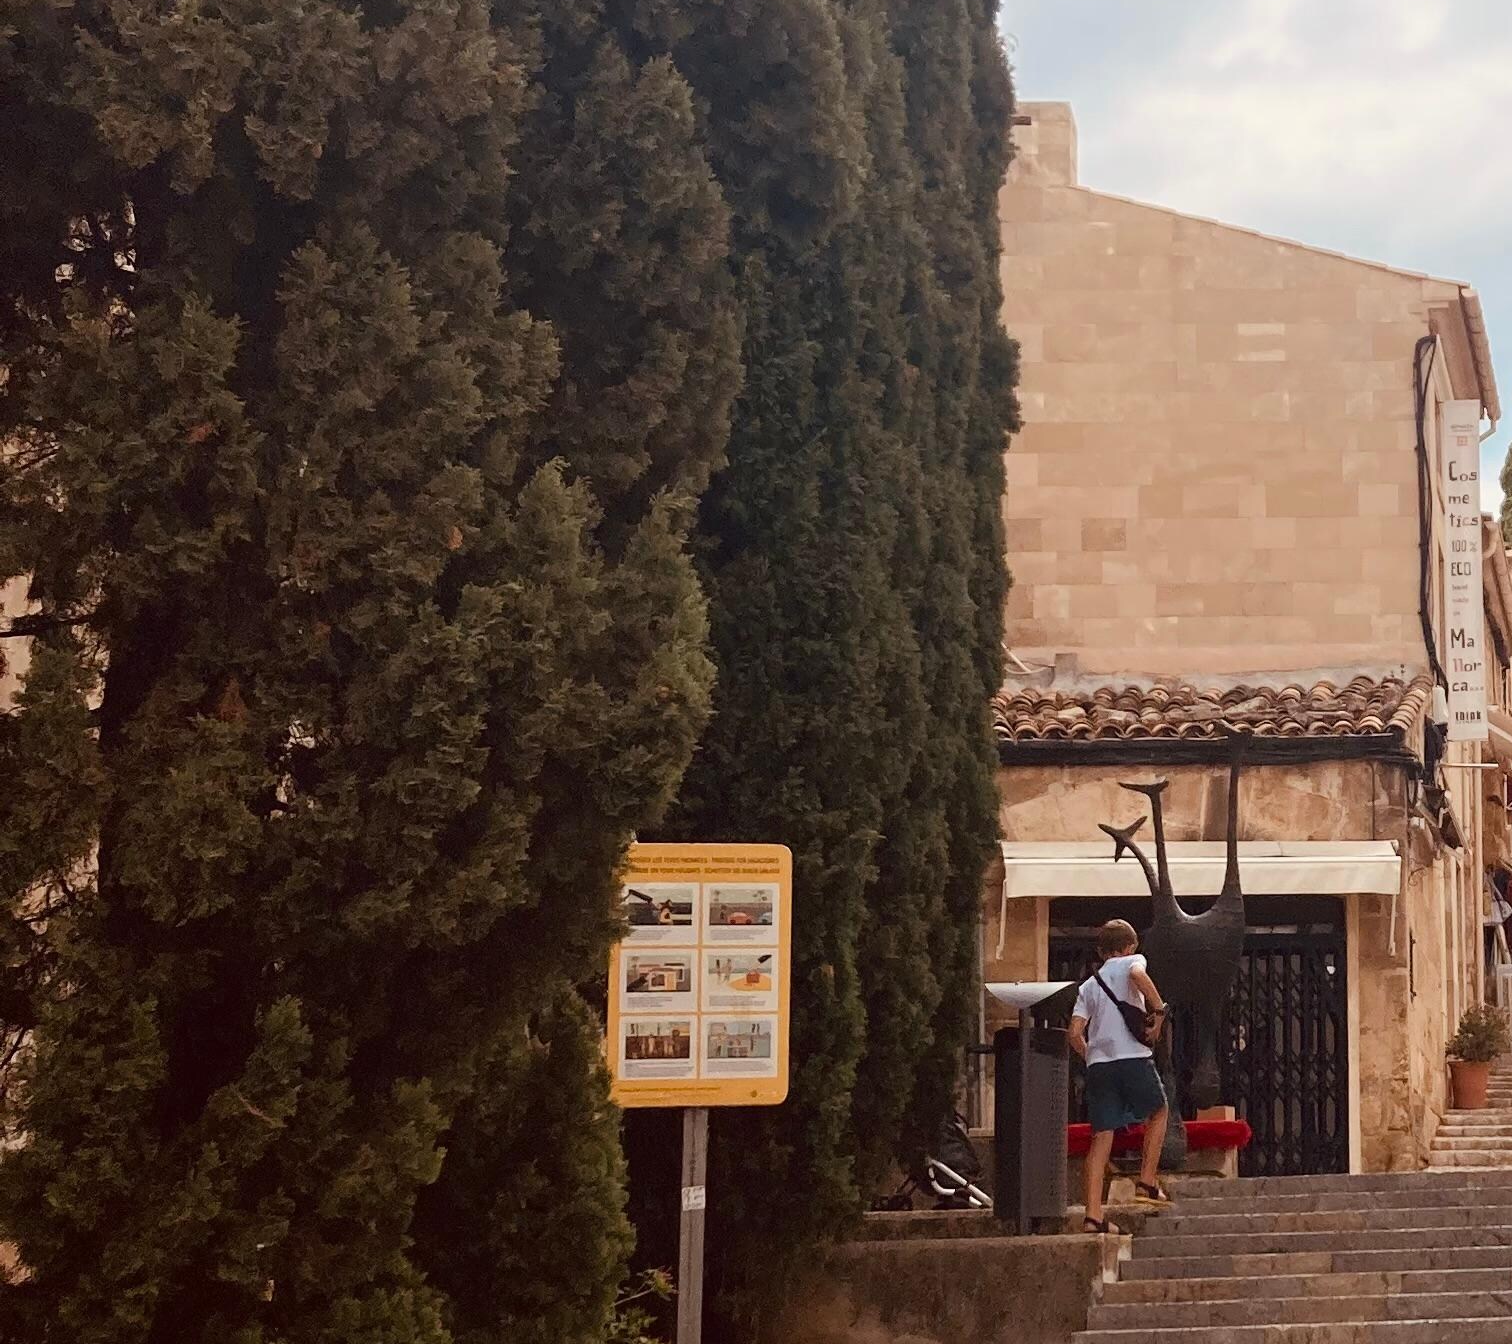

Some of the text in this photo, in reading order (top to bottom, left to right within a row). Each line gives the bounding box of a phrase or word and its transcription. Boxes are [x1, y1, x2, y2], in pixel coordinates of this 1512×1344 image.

[1449, 461, 1478, 481] Cos
[1448, 493, 1470, 504] me
[1449, 512, 1479, 528] tics
[1451, 562, 1472, 576] ECO
[1450, 628, 1475, 649] Ma
[1453, 658, 1482, 673] llor
